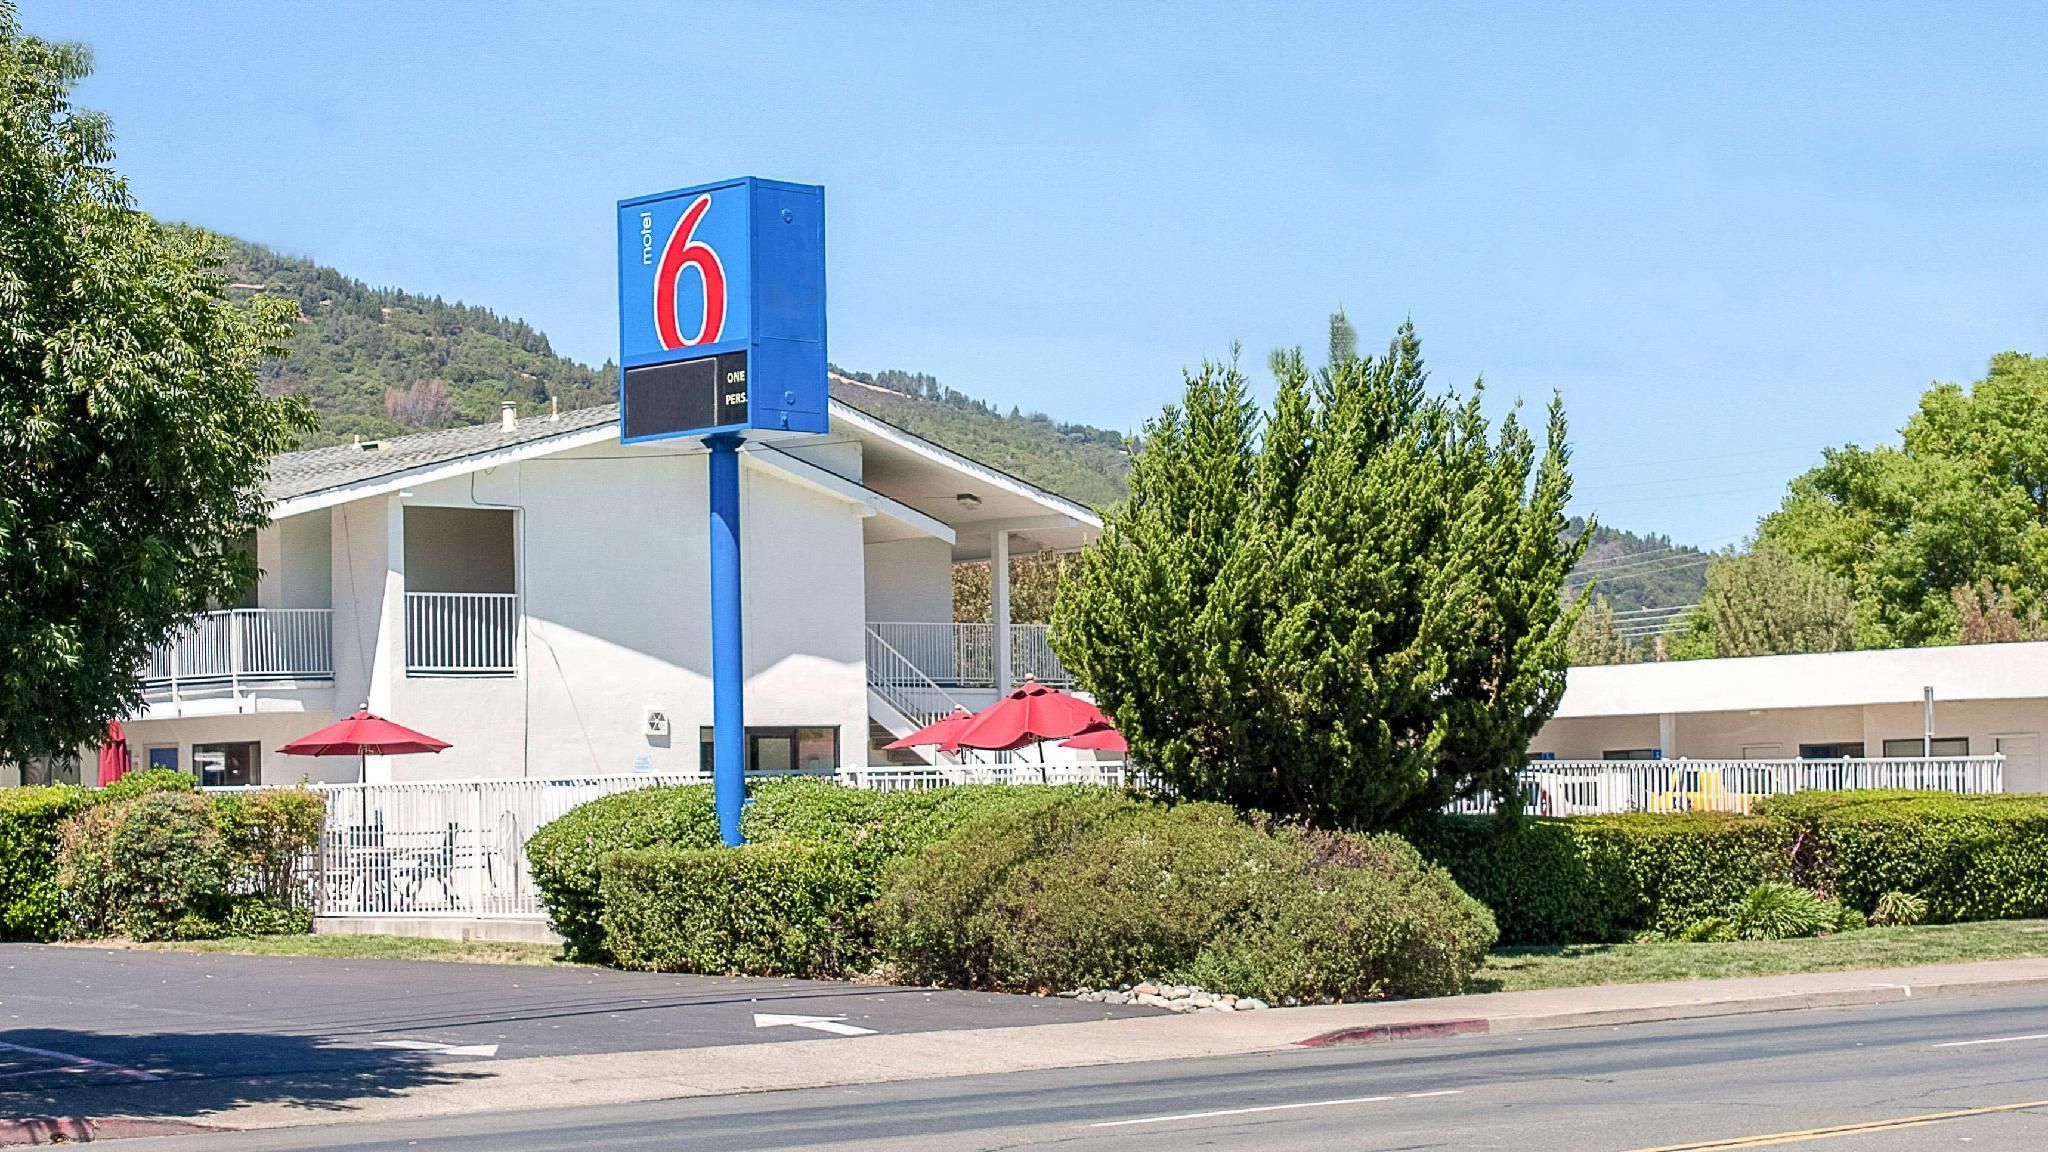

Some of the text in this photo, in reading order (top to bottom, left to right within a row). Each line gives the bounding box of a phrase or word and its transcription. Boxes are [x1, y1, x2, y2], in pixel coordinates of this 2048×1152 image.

[640, 211, 653, 265] motel
[653, 192, 727, 350] 6
[727, 370, 745, 383] ONE
[1041, 550, 1054, 562] EXIT
